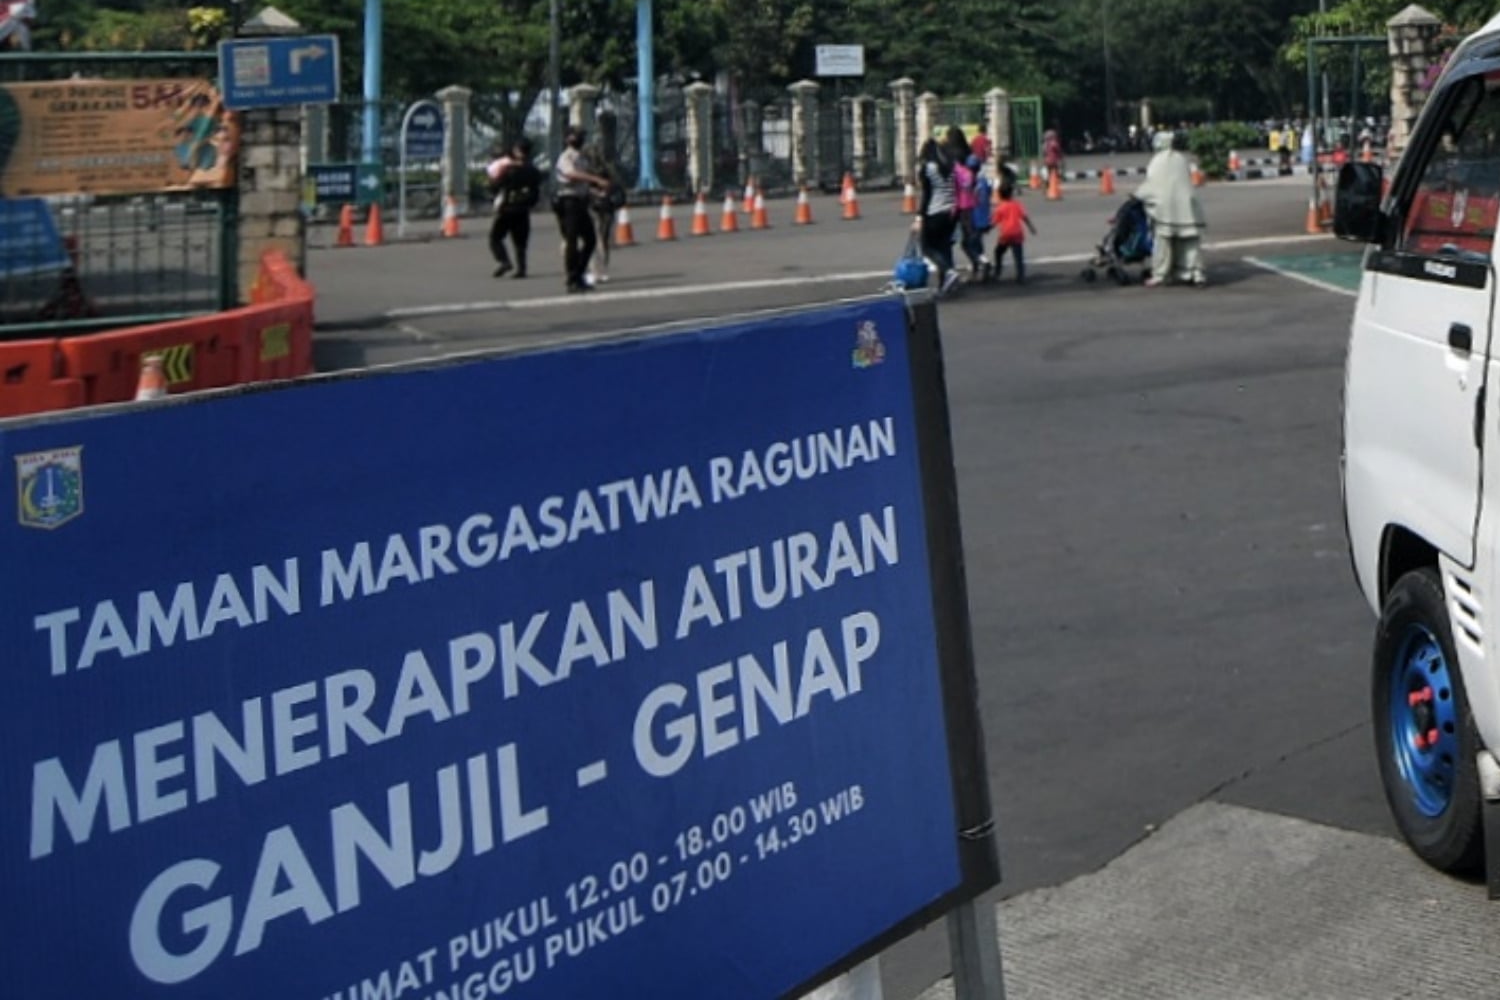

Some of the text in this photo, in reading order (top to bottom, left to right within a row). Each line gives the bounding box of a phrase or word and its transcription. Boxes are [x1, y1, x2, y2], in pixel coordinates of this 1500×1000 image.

[35, 417, 896, 675] TAMAN MARGASATWA RAGUNAN
[31, 506, 898, 858] MENERAPKAN ATURAN
[130, 611, 880, 983] GANJIL - GENAP
[323, 948, 437, 1000] MAT
[449, 897, 558, 971] PUKUL
[565, 852, 649, 913] 12.00
[674, 806, 747, 861] 18.00
[749, 781, 798, 823] WIB
[545, 896, 645, 968] PUKUL
[651, 852, 732, 912] 07.00
[754, 808, 818, 860] 14.30
[818, 784, 865, 825] WIB
